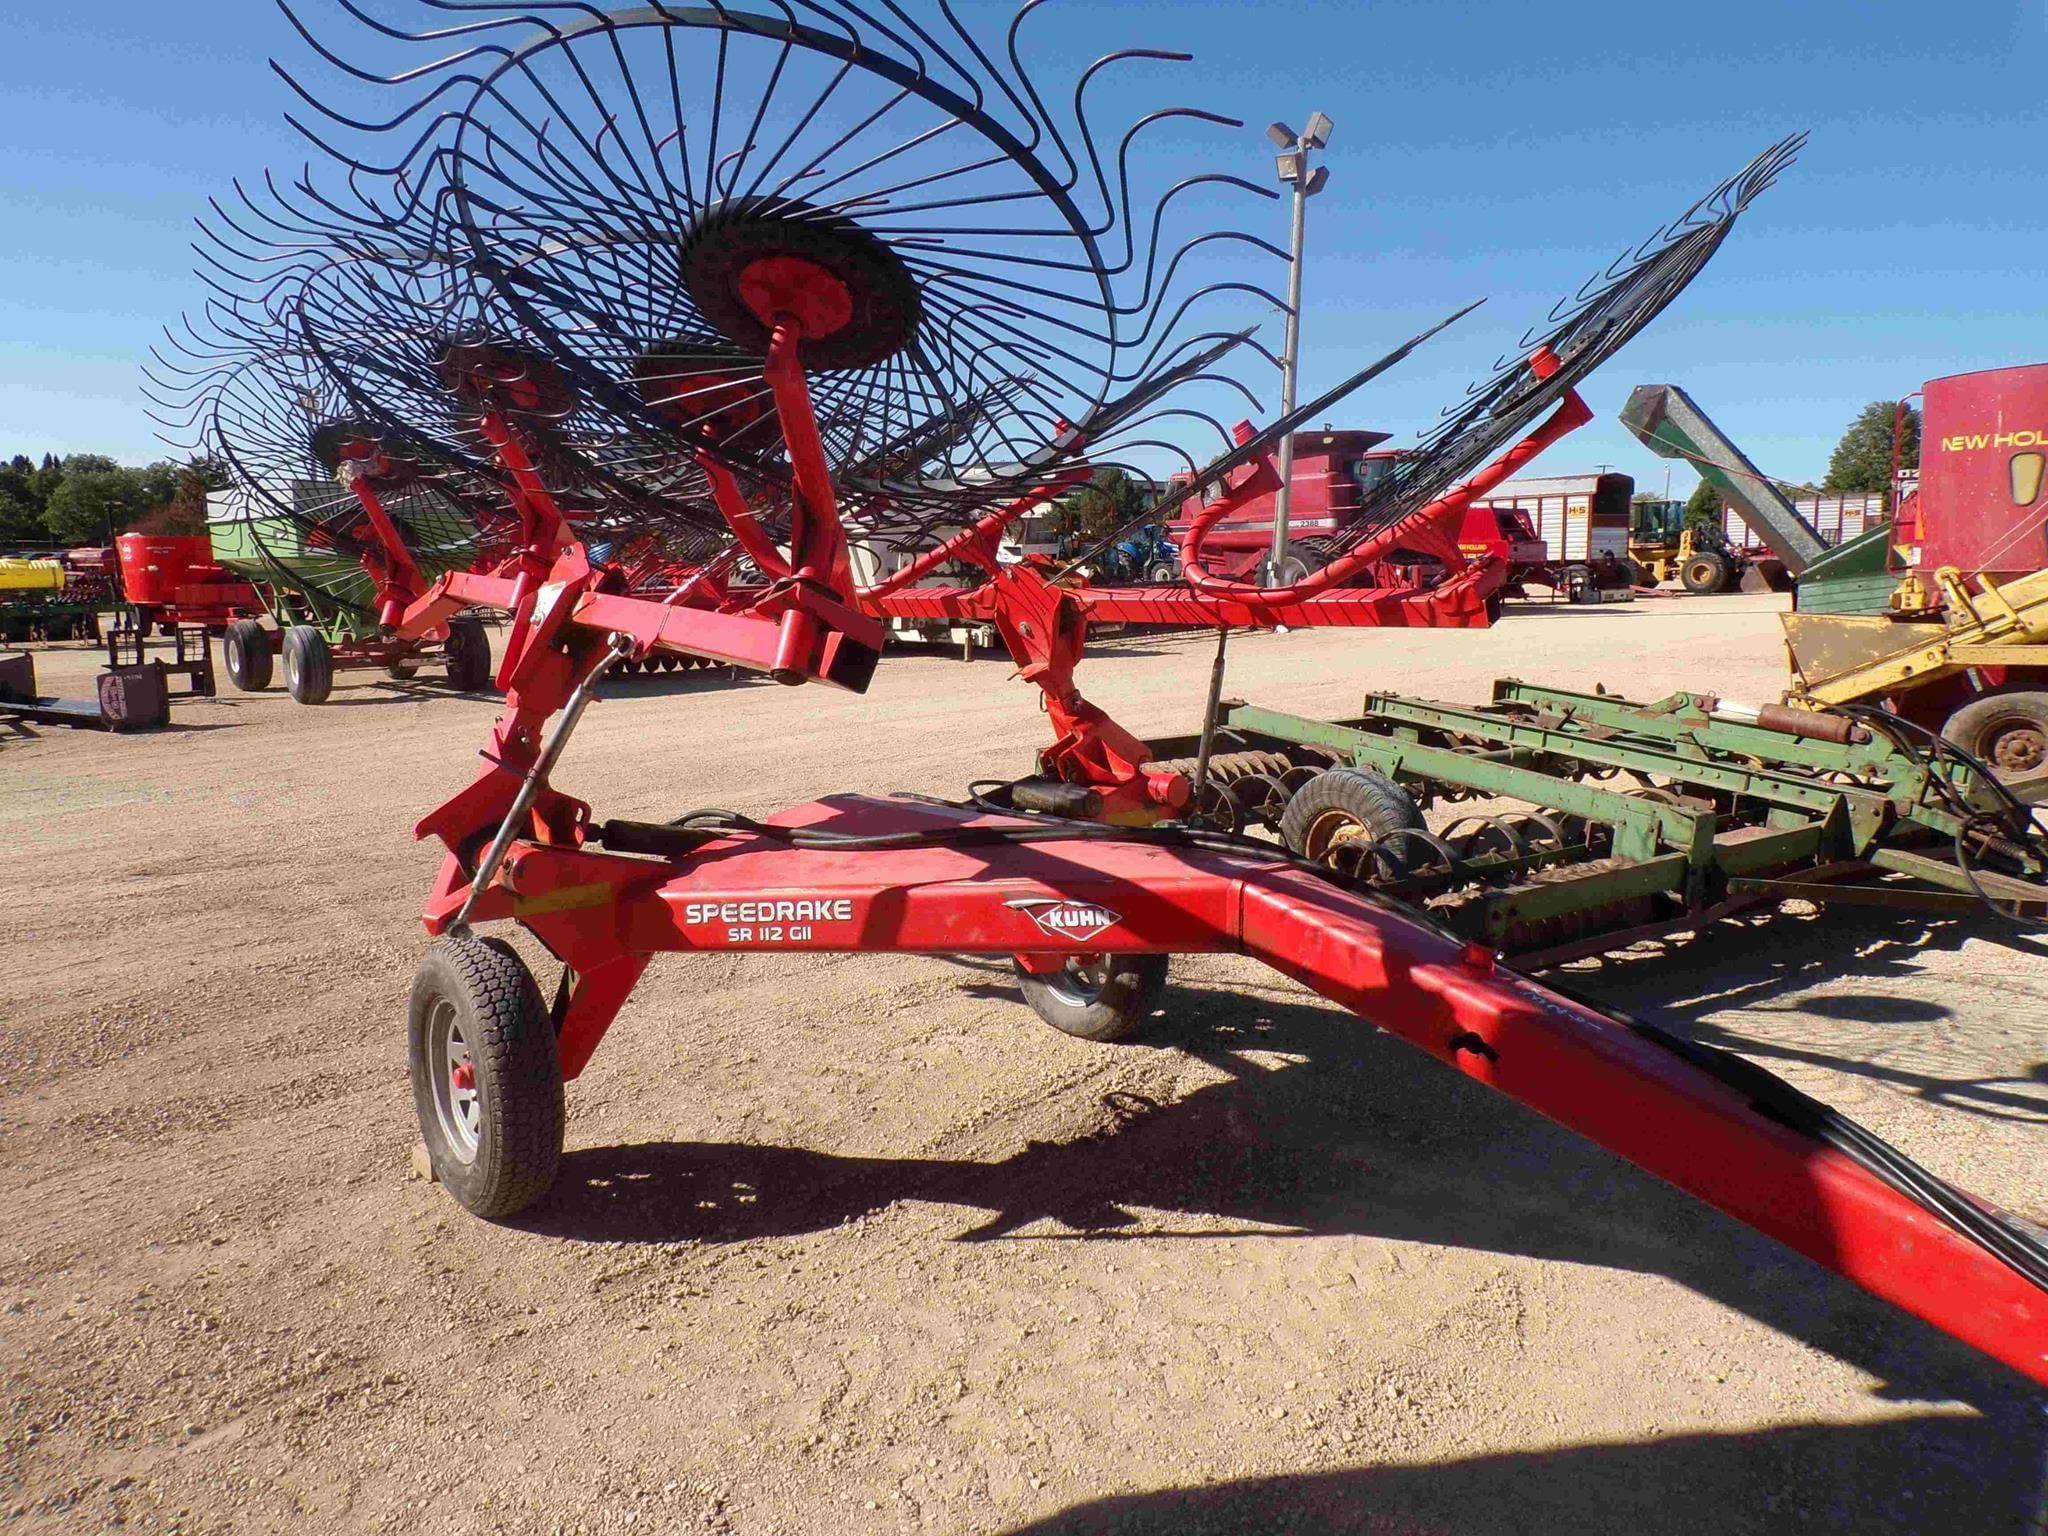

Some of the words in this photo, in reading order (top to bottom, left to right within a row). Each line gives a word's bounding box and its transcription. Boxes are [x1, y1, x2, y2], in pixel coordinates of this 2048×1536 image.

[1942, 433, 1990, 452] NEW
[1994, 430, 2048, 448] HOL
[686, 899, 852, 924] SPEEDRAKE
[1049, 908, 1111, 927] KUHN
[728, 927, 753, 942] SR
[759, 926, 783, 941] 112
